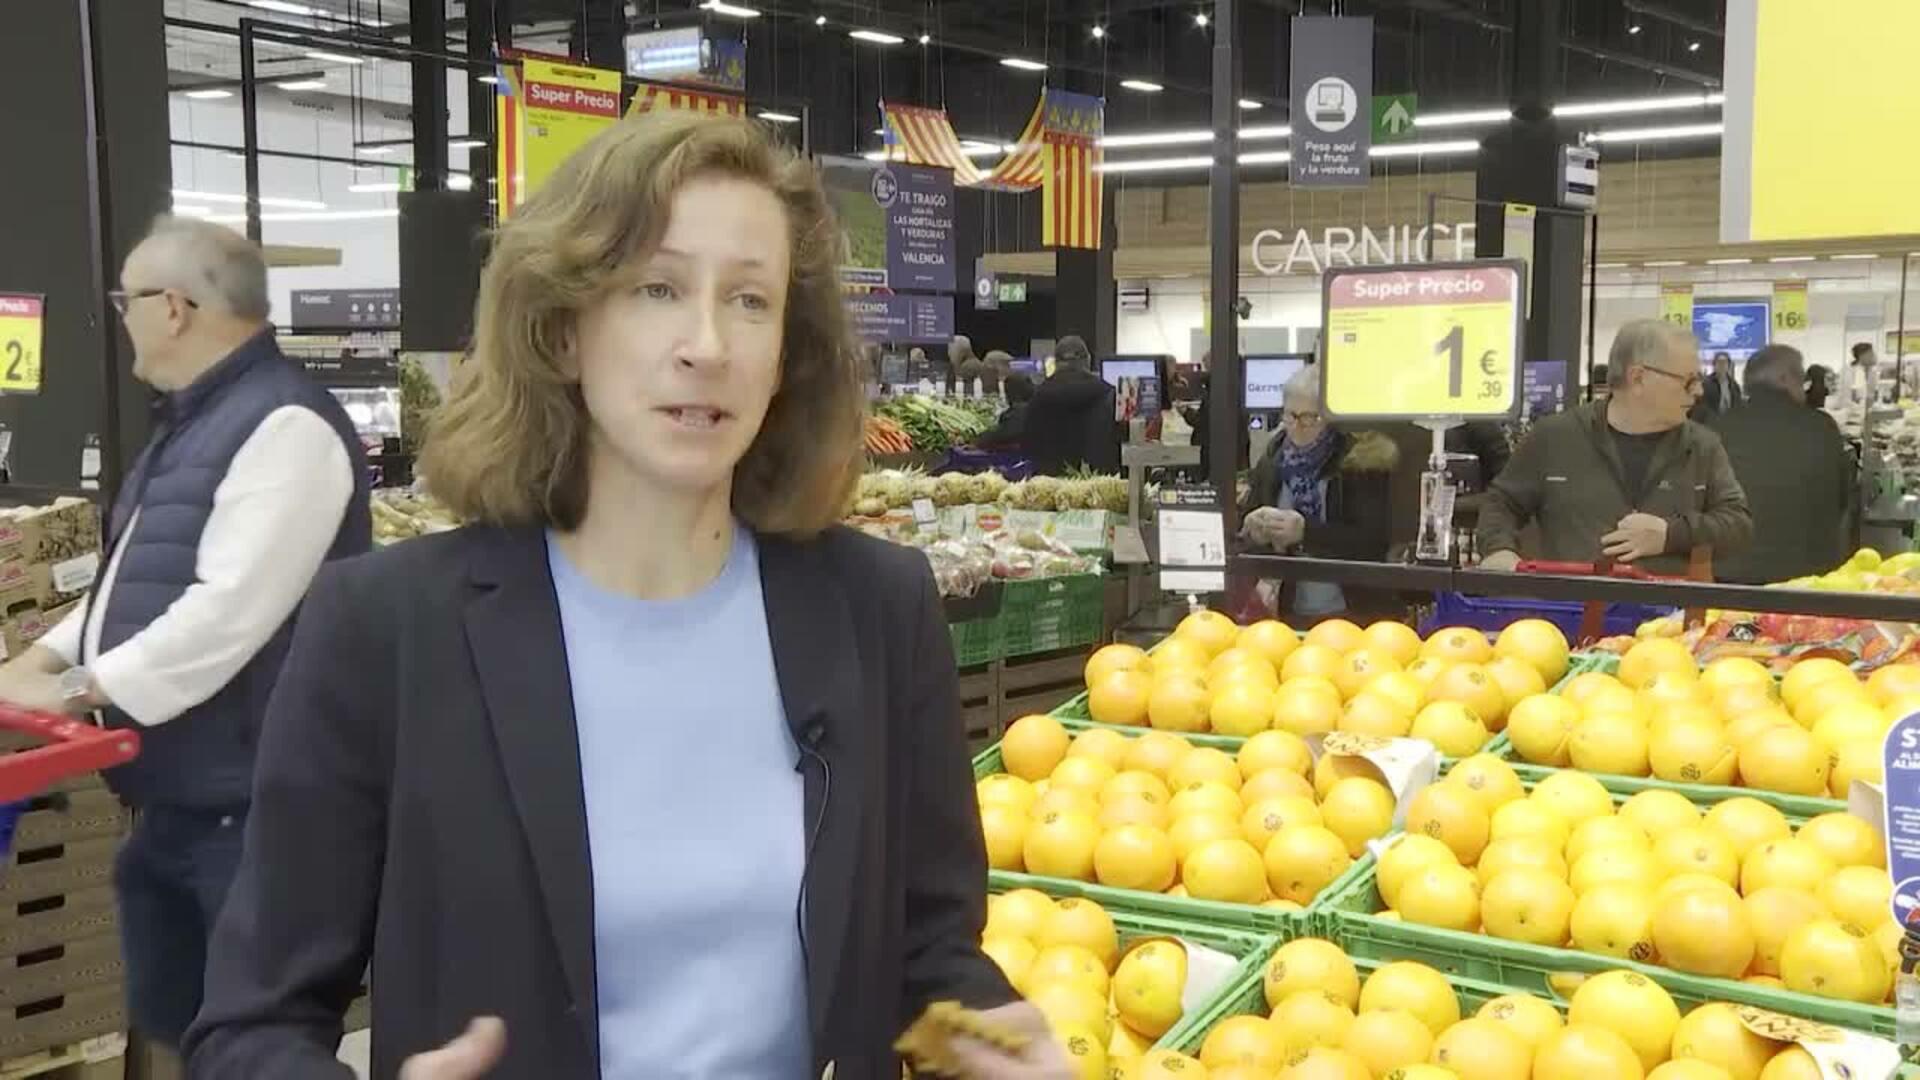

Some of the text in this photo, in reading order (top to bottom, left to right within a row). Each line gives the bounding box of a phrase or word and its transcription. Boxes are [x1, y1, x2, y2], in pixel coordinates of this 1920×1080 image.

[531, 84, 615, 109] Super Precio
[1305, 141, 1357, 153] Pesa aquí
[1312, 152, 1349, 163] la fruta
[1309, 163, 1319, 174] la
[1320, 164, 1360, 175] verdura
[900, 192, 946, 207] TE TRAIGO
[893, 215, 907, 225] LAS
[902, 227, 945, 240] Y VERDURAS
[902, 252, 945, 265] VALENCIA
[1352, 273, 1485, 299] Super Precio
[6, 340, 23, 381] 2
[1434, 325, 1464, 398] 1
[1479, 350, 1498, 376] €
